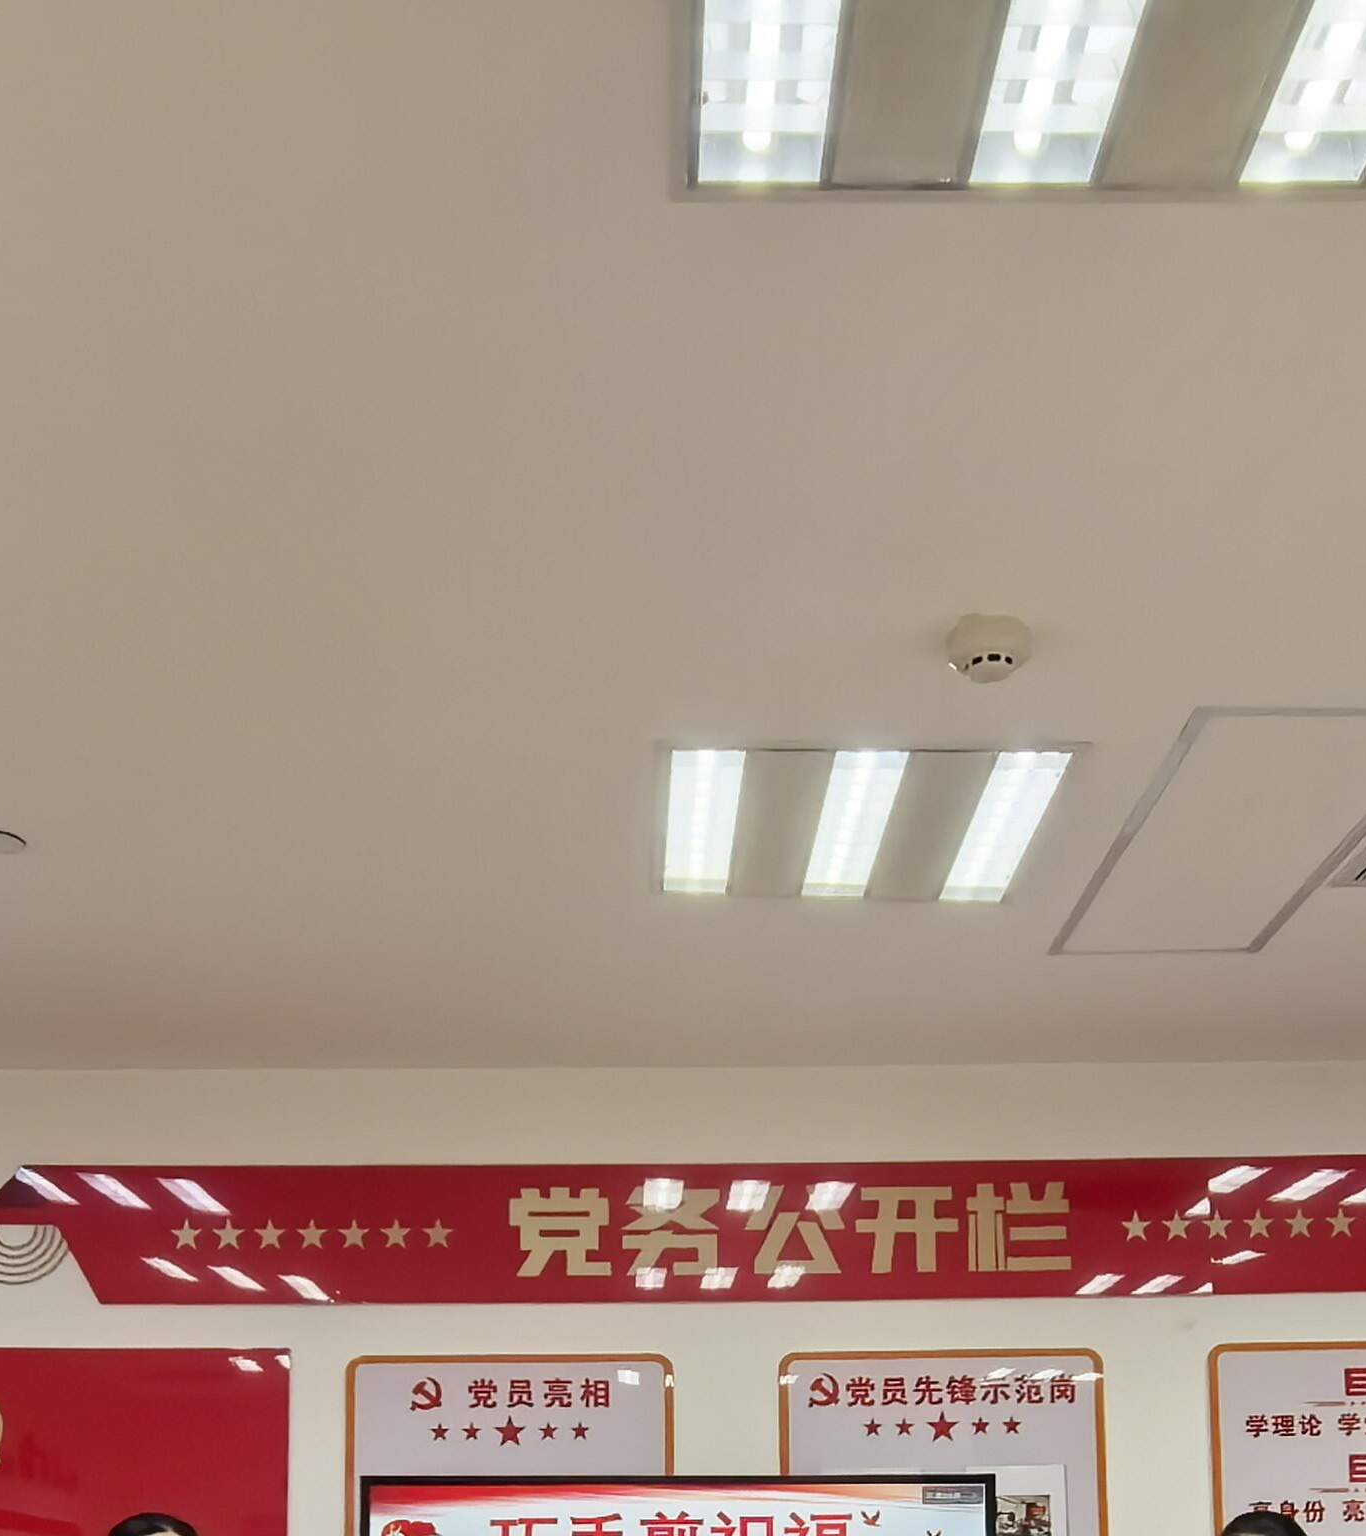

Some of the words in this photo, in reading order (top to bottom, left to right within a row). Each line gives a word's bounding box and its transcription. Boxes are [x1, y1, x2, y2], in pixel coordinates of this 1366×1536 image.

[509, 1182, 1072, 1278] 党务公开栏
[468, 1378, 610, 1408] 党员亮相
[845, 1374, 1076, 1407] 党员先锋示范岗
[1246, 1414, 1323, 1437] 学理论
